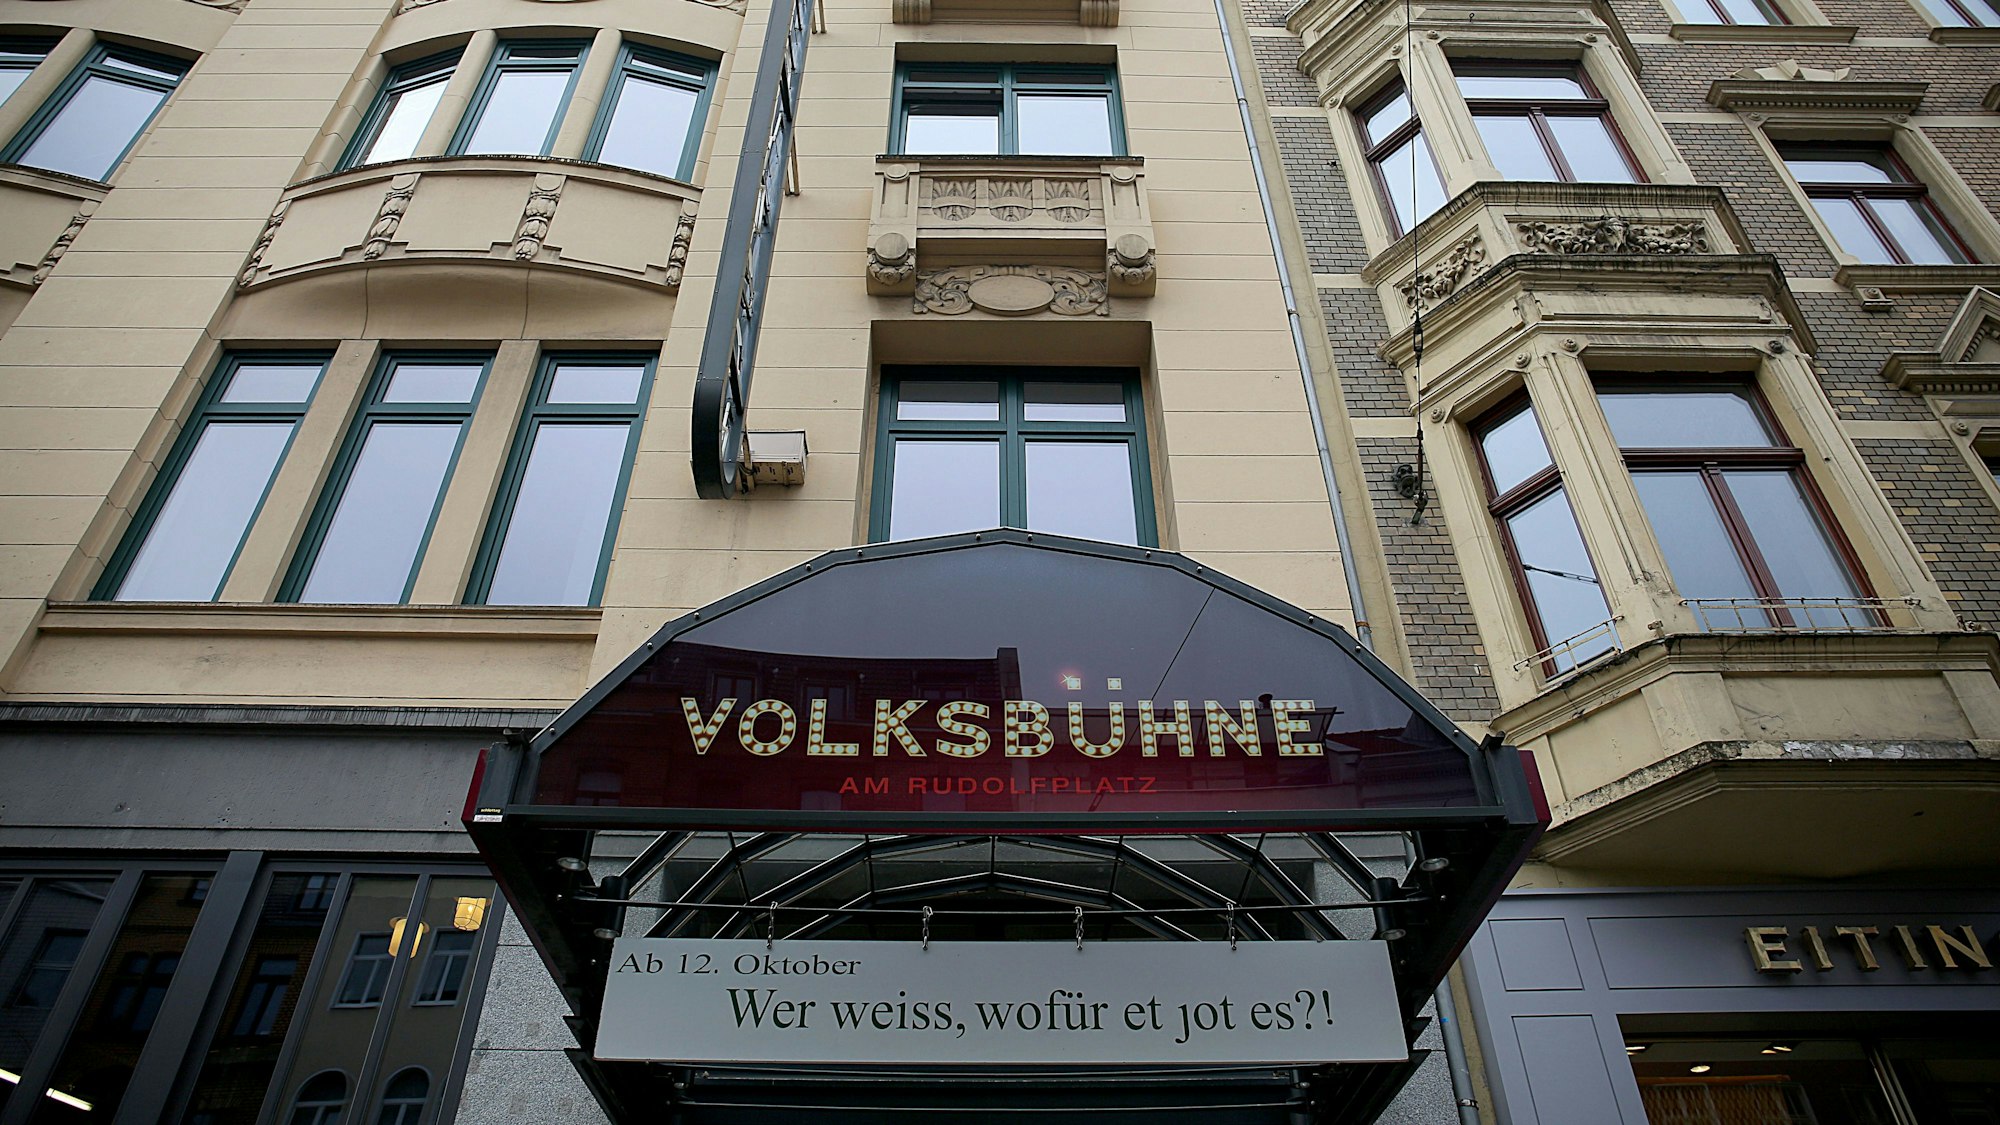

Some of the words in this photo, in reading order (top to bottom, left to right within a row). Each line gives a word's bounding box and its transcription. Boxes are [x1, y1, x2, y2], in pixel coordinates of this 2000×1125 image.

[681, 678, 1324, 758] VOLKSBÜHNE
[839, 776, 888, 794] AM
[908, 776, 1158, 795] RUDOLFPLATZ
[616, 953, 664, 975] Ab
[677, 954, 720, 975] 12.
[734, 953, 862, 976] Oktober
[1744, 925, 2000, 975] EITIN
[726, 988, 816, 1029] Wer
[830, 991, 967, 1038] weiss,
[975, 989, 1109, 1031] wofür
[1124, 996, 1164, 1031] et
[1175, 995, 1238, 1044] jot
[1250, 989, 1335, 1031] es?!
